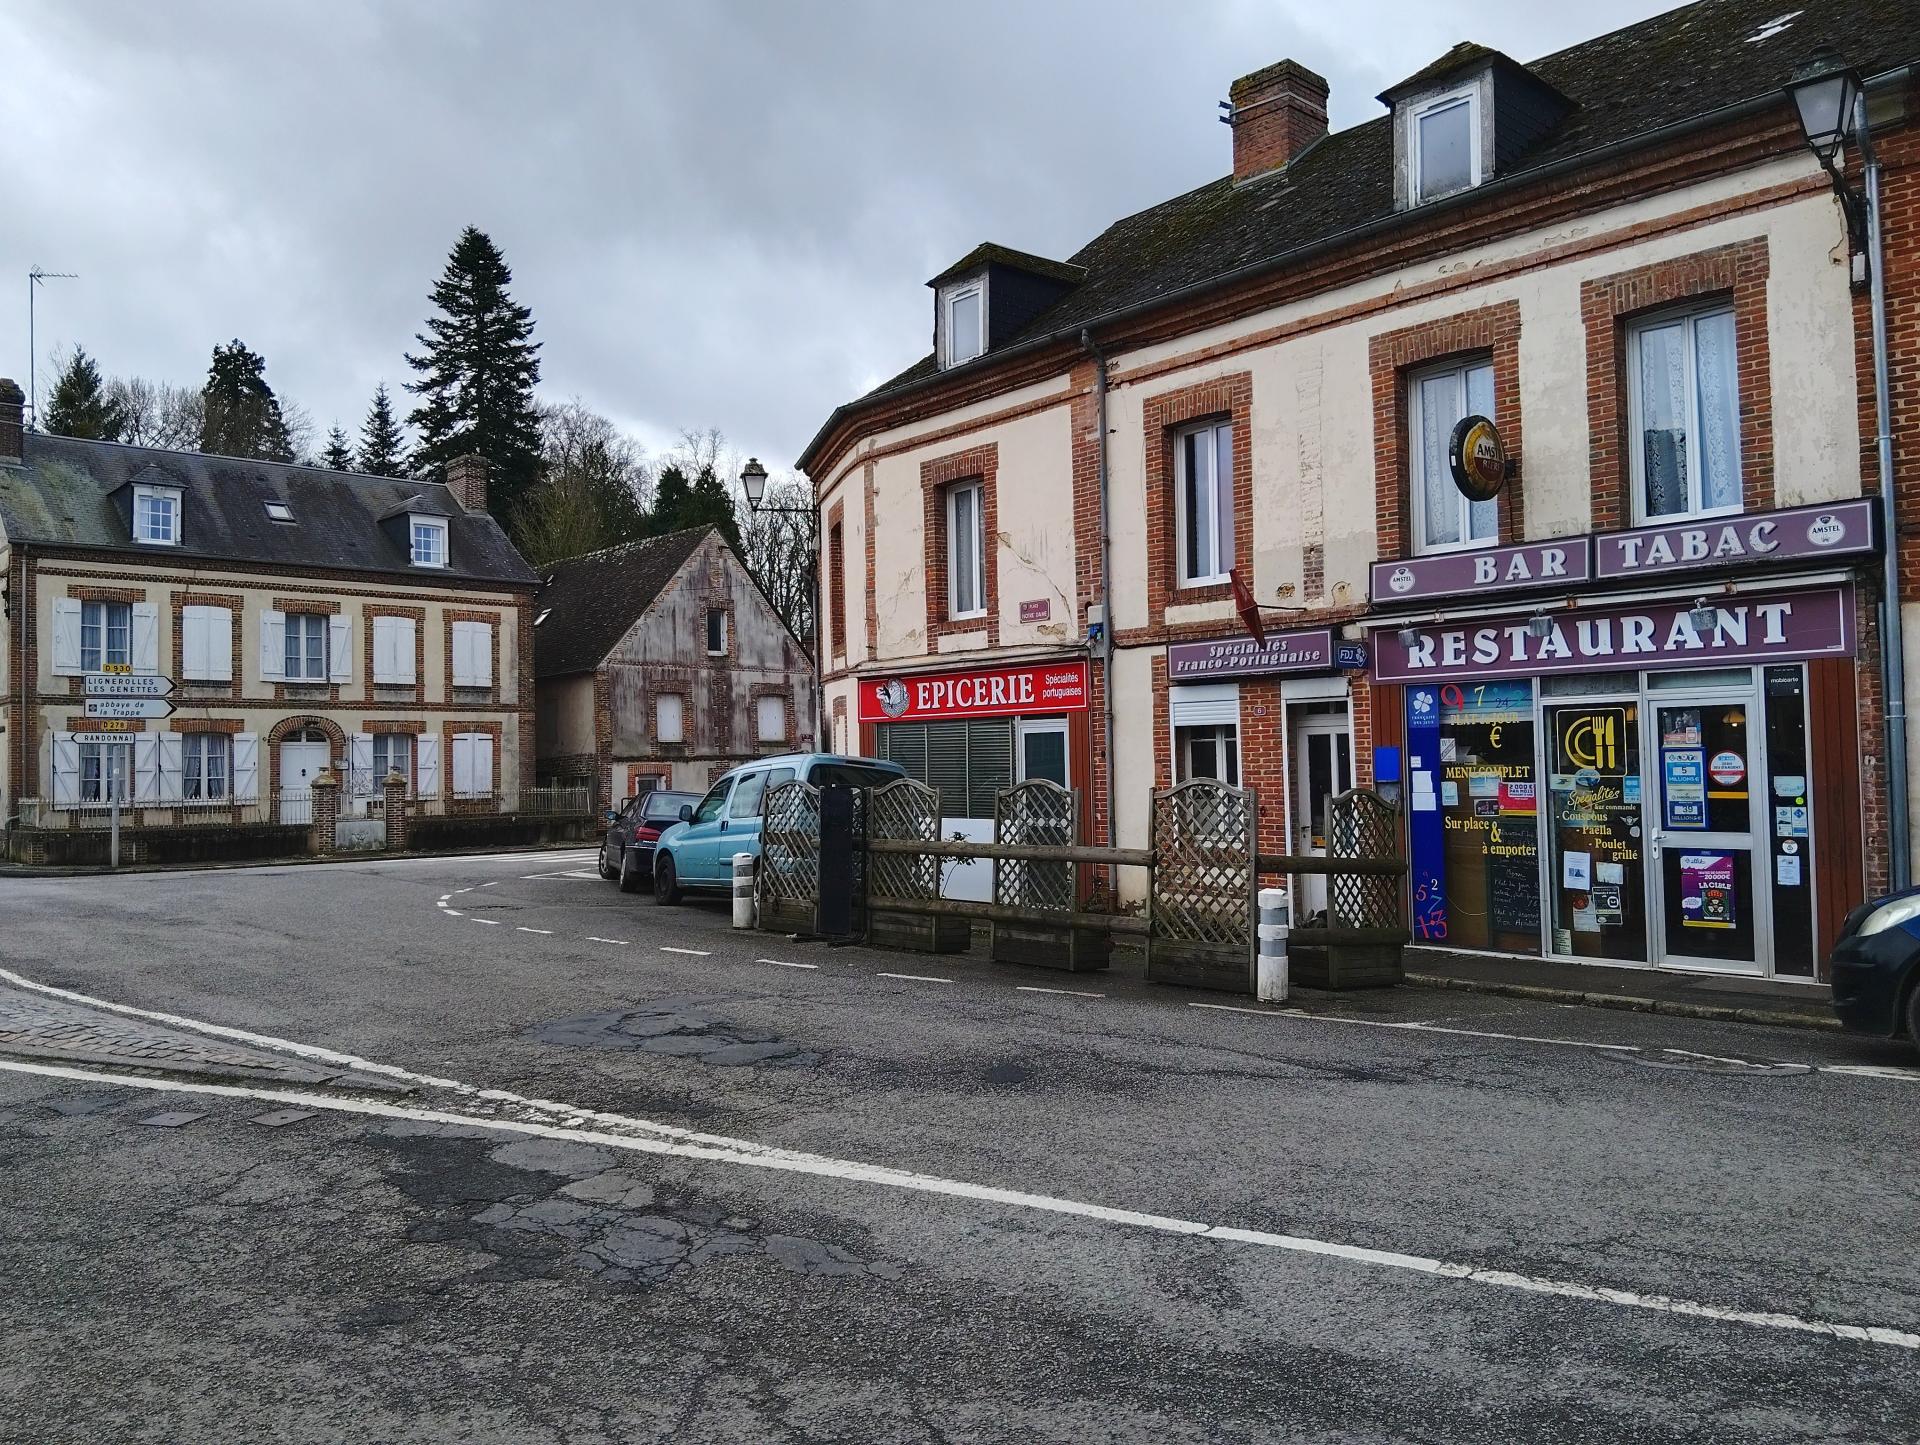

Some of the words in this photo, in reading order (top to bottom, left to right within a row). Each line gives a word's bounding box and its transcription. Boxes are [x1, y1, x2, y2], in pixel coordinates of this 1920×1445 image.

[1812, 525, 1840, 534] AMSTEL
[1618, 521, 1779, 568] TABAC
[1474, 549, 1567, 584] BAR
[1407, 602, 1792, 669] RESTAURANT
[1209, 640, 1288, 658] Spécialtés
[1340, 650, 1353, 659] FDJ
[1177, 649, 1321, 672] Franco-Portuguaise
[1045, 672, 1079, 685] Spécialités
[917, 673, 1035, 710] EPICERIE
[1042, 686, 1082, 700] portuguaises
[1441, 684, 1464, 712] 9
[1474, 685, 1485, 707] 7
[100, 701, 130, 709] abbaye
[113, 709, 140, 717] Trappe
[1489, 726, 1502, 749] €
[1446, 767, 1478, 778] MENU
[1479, 765, 1530, 778] COMPLET
[1567, 785, 1620, 810] Spécialités
[1562, 810, 1608, 821] Couscous
[1445, 816, 1462, 829] Sur
[1464, 816, 1489, 832] place
[1490, 821, 1502, 843] &
[1482, 842, 1488, 854] à
[1490, 843, 1537, 858] emporter
[1595, 838, 1626, 850] Poulet
[1612, 850, 1638, 862] grillé
[1415, 884, 1428, 901] 5
[1431, 879, 1438, 891] 2
[1427, 895, 1442, 914] 7
